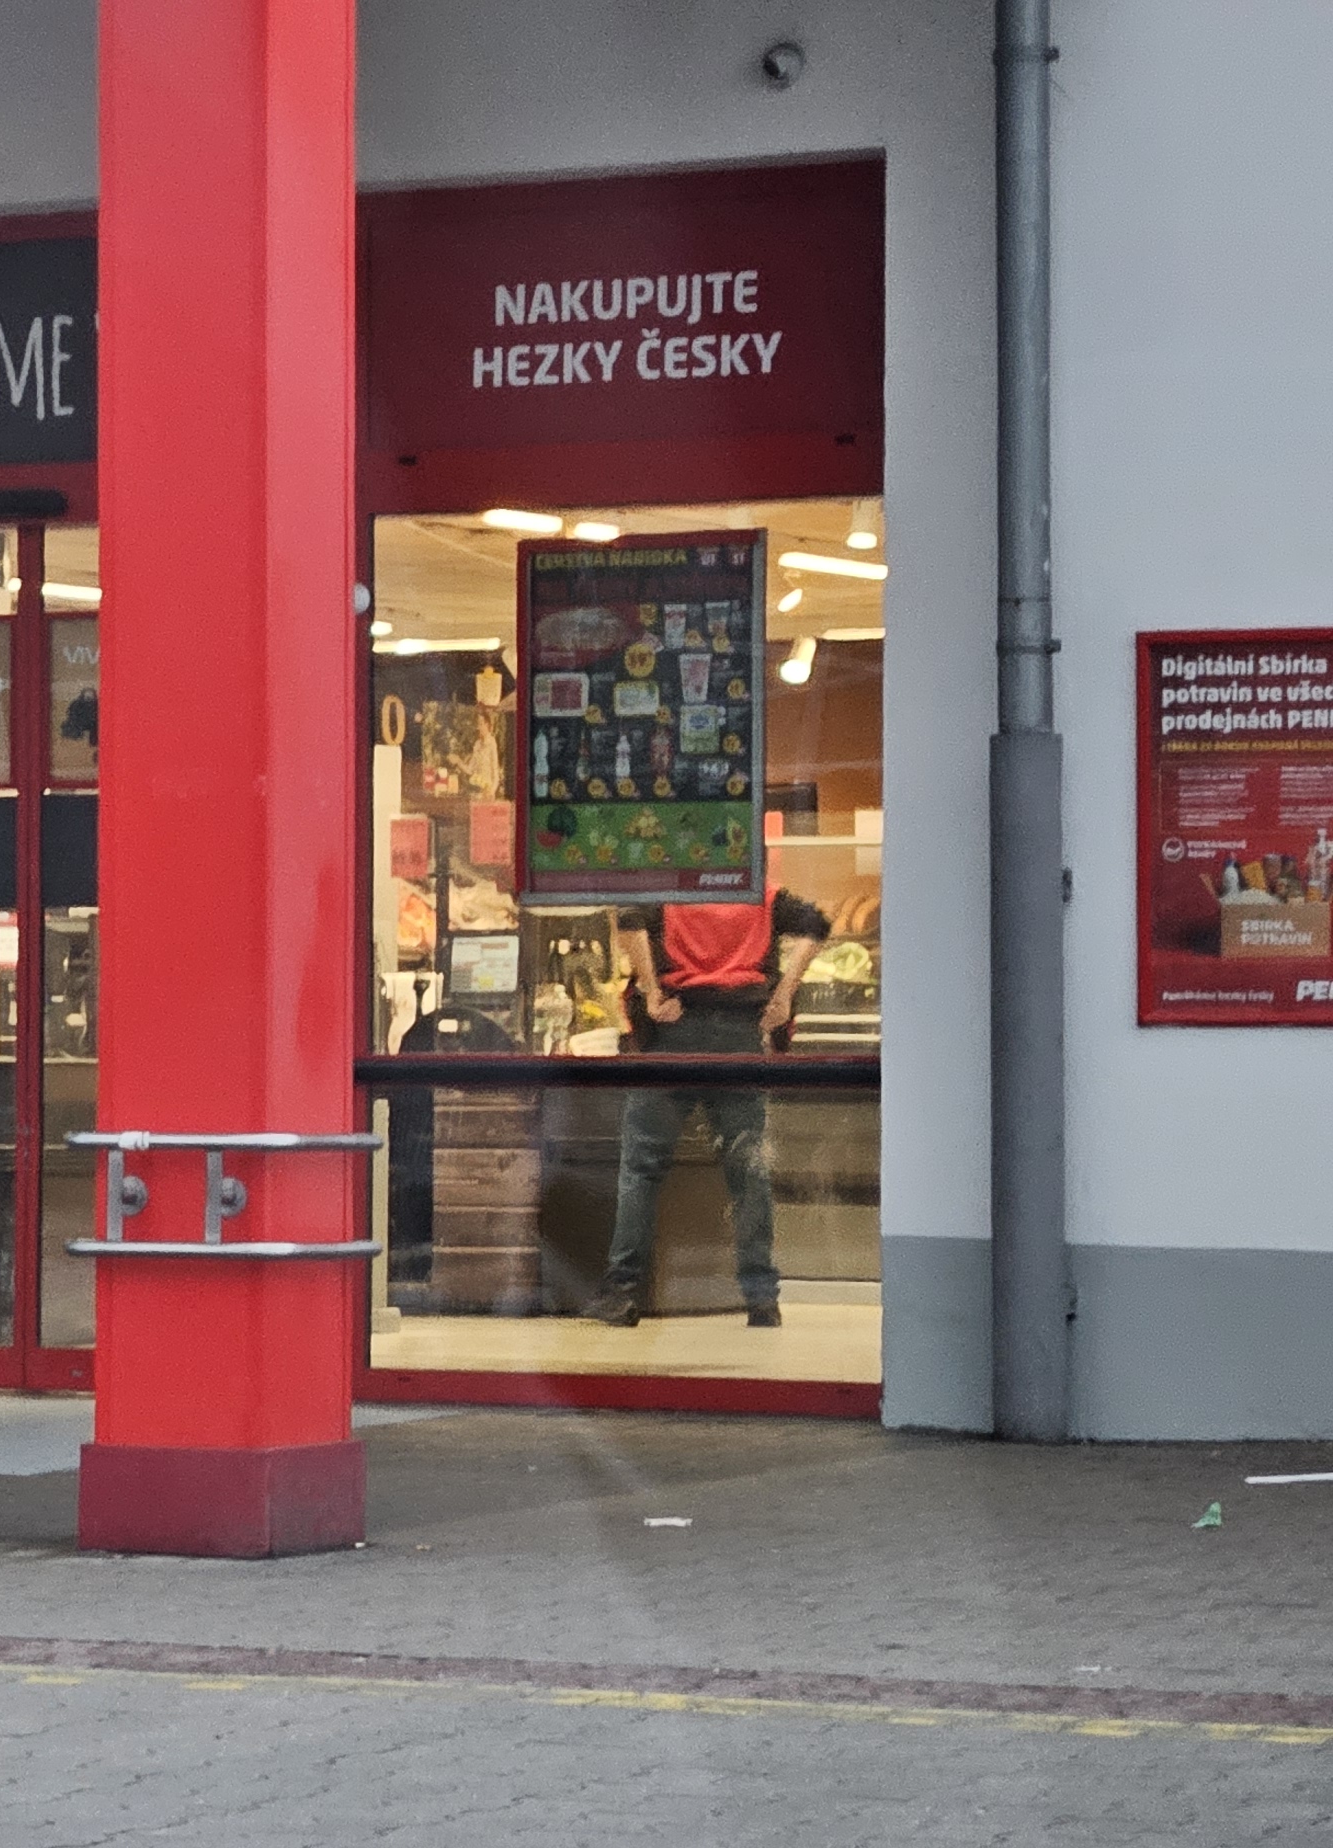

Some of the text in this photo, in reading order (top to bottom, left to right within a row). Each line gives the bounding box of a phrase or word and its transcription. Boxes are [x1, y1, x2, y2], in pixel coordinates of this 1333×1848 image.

[493, 269, 758, 327] NAKUPUJTE
[472, 327, 783, 388] HEZKY ČESKY
[1161, 652, 1329, 681] Digitální Sbírka
[1161, 680, 1253, 709] potravin
[1256, 686, 1283, 702] ve
[1161, 707, 1333, 736] prodejnách PEN
